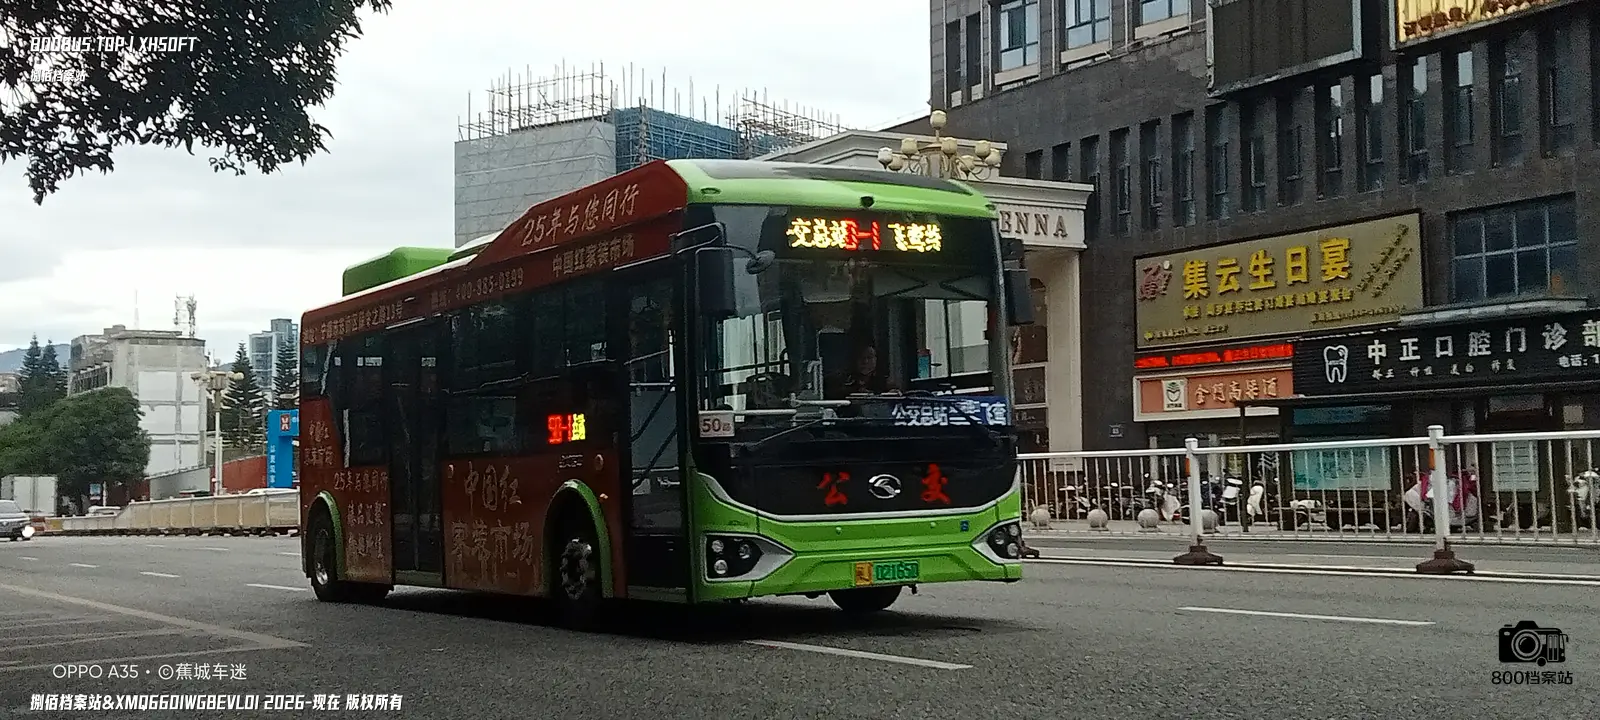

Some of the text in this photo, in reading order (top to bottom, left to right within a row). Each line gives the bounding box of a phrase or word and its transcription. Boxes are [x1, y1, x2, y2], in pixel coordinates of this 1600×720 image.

[520, 182, 640, 248] 25年与您同行
[1182, 237, 1351, 300] 集云生日宴
[1368, 319, 1600, 365] 中正口腔门诊部
[817, 463, 951, 505] 公 交
